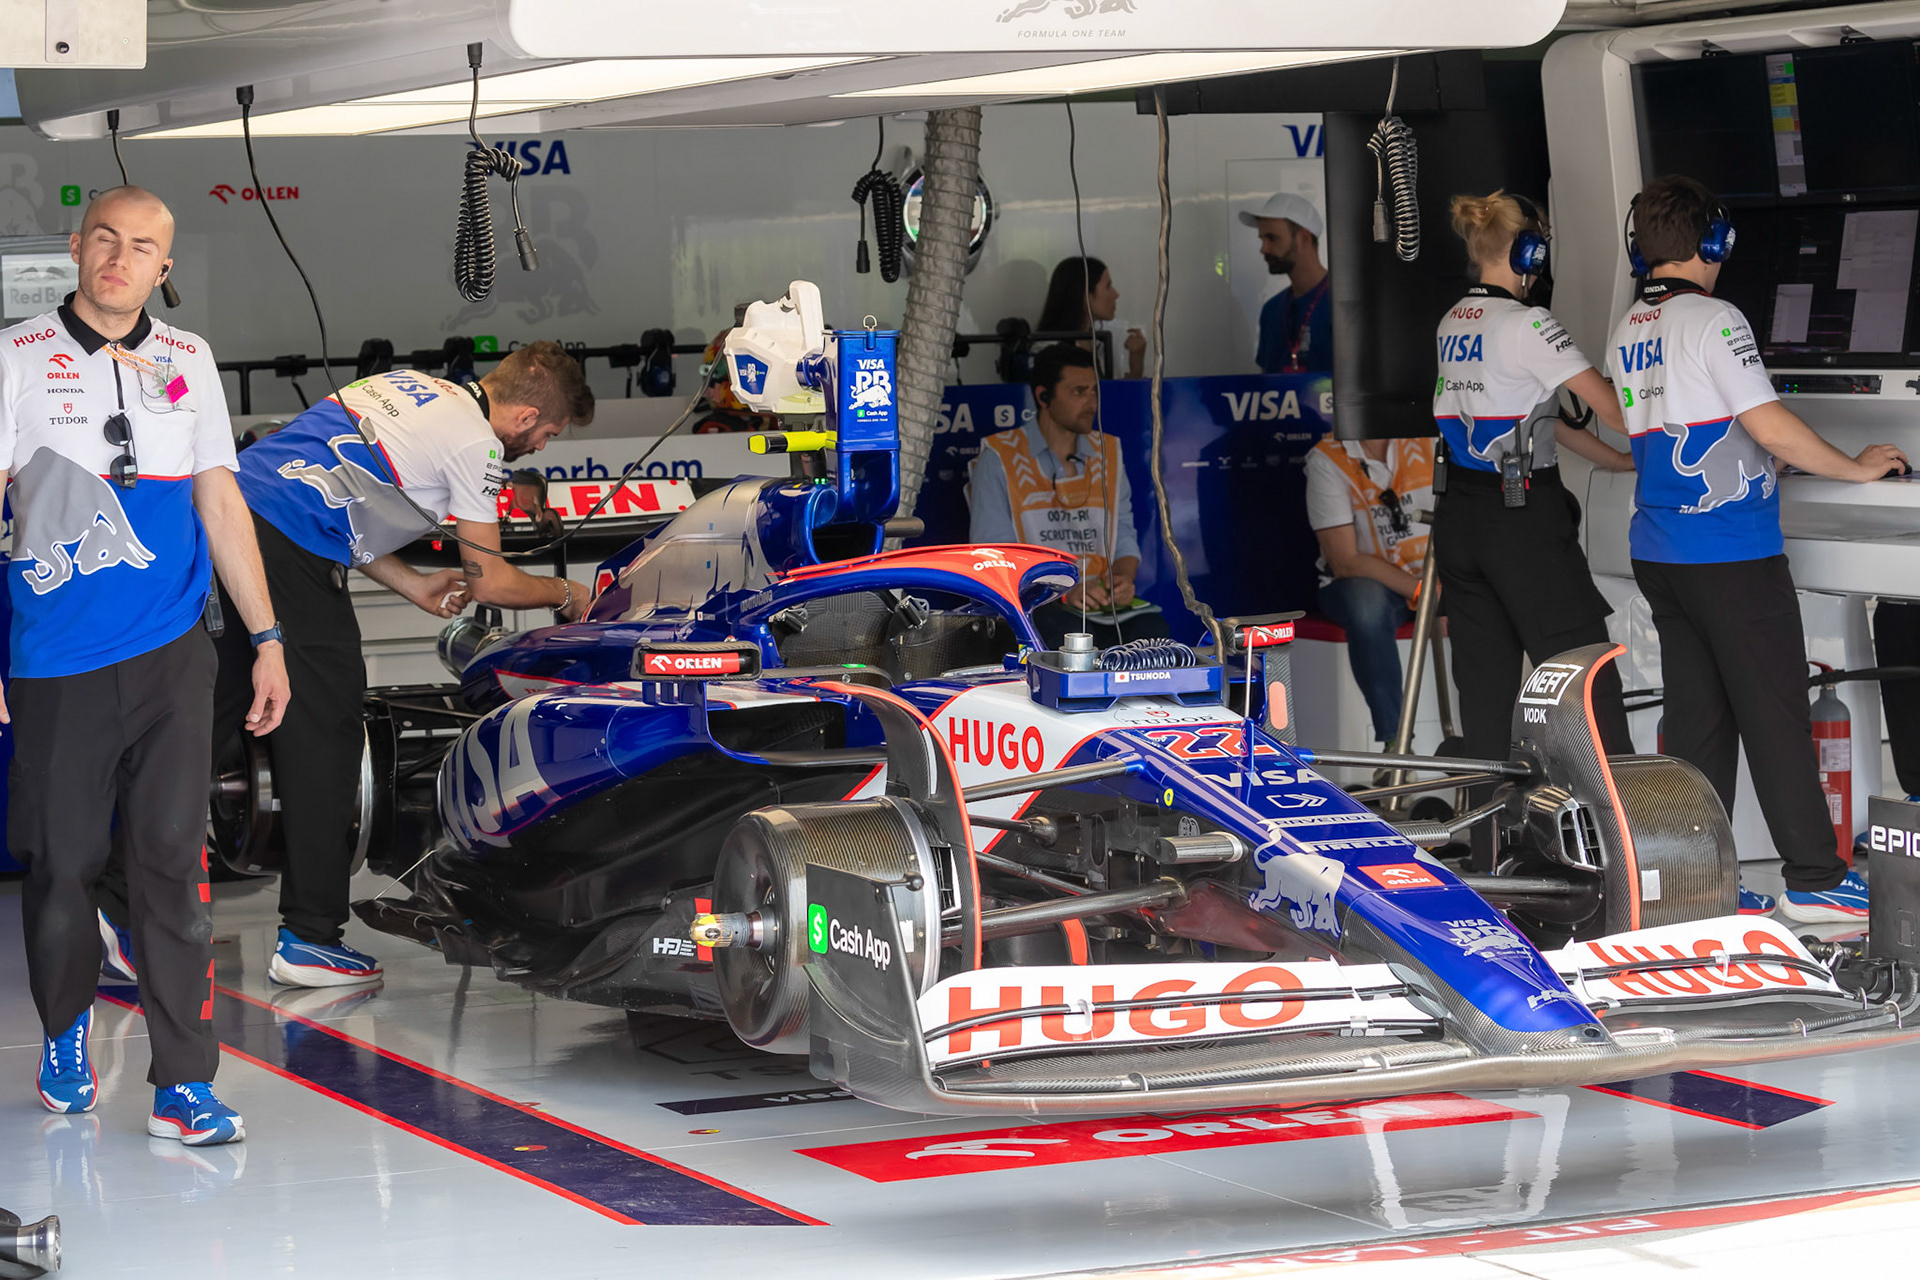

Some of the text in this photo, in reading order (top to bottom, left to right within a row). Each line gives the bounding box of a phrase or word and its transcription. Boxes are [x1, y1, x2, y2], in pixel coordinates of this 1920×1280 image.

[1017, 29, 1126, 38] FORMULA ONE TEAM
[1281, 124, 1324, 157] VI
[10, 287, 42, 304] Red
[1644, 284, 1668, 294] ONDA
[1450, 308, 1484, 320] HUGO
[1629, 308, 1662, 325] HUGO
[13, 328, 56, 348] HUGO
[155, 334, 196, 354] HUGO
[1439, 334, 1484, 363] VISA
[1617, 336, 1664, 374] VISA
[153, 355, 173, 363] VISA
[856, 359, 885, 369] VISA
[382, 370, 440, 408] VISA
[1445, 380, 1485, 393] Cash App
[1221, 390, 1301, 421] VISA
[49, 417, 89, 425] TUDOR
[973, 559, 1017, 571] ORLEN
[1273, 626, 1293, 638] ORLEN
[674, 657, 722, 670] ORLEN
[1130, 671, 1171, 681] TSUNODA
[1125, 714, 1219, 726] TUDOR
[949, 717, 1044, 774] HUGO
[1145, 727, 1282, 762] 22
[1194, 768, 1331, 788] VISA
[1387, 877, 1431, 885] ORLEN
[1441, 918, 1491, 928] VISA
[829, 918, 862, 953] Cash
[865, 928, 891, 971] App
[1586, 930, 1807, 996] HUGO
[948, 966, 1305, 1055] HUGO
[1093, 1101, 1432, 1143] ORLEN
